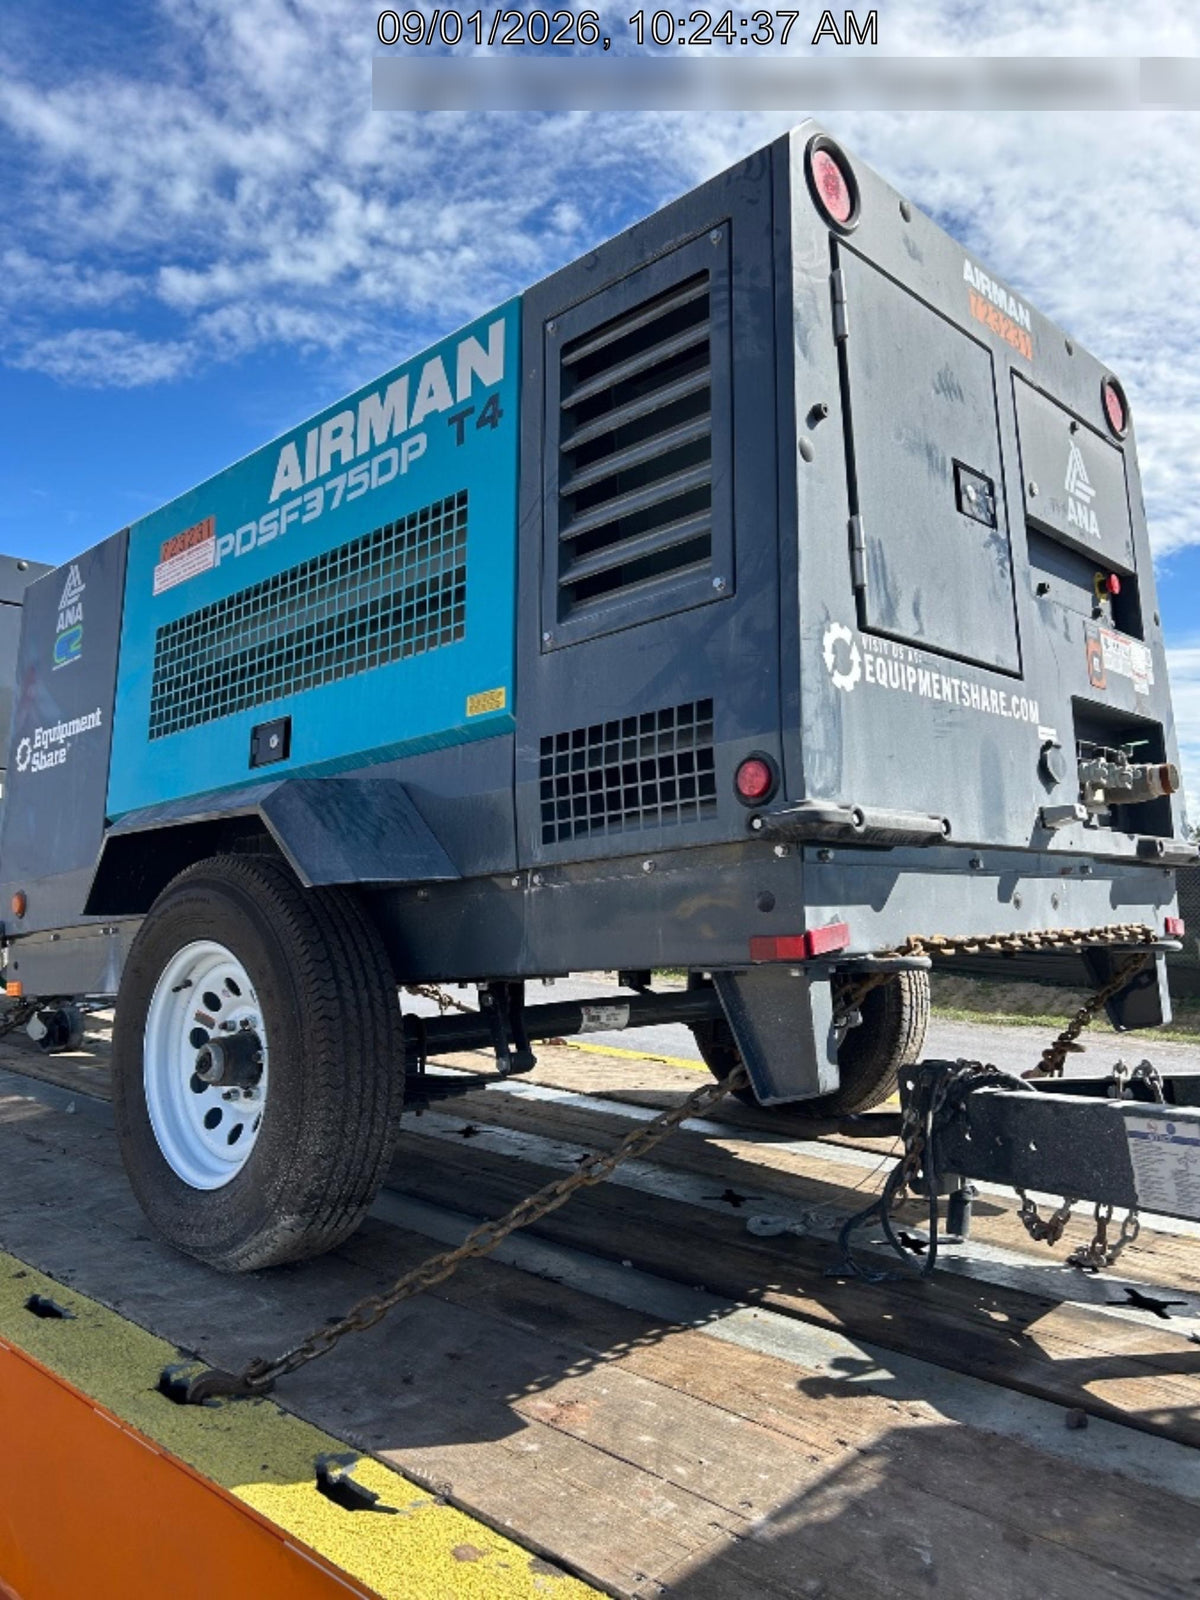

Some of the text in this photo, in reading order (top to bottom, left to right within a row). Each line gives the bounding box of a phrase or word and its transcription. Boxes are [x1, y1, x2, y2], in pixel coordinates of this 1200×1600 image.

[963, 258, 1031, 332] AIRMAN
[268, 317, 506, 503] AIRMAN
[447, 392, 504, 447] T4
[214, 431, 428, 567] PDSF375DP
[1067, 497, 1101, 540] ANA
[56, 602, 83, 633] ANA
[863, 652, 1040, 724] EQUIPMENTSHARE.COM
[33, 707, 102, 749] Equipment
[31, 749, 67, 773] Share
